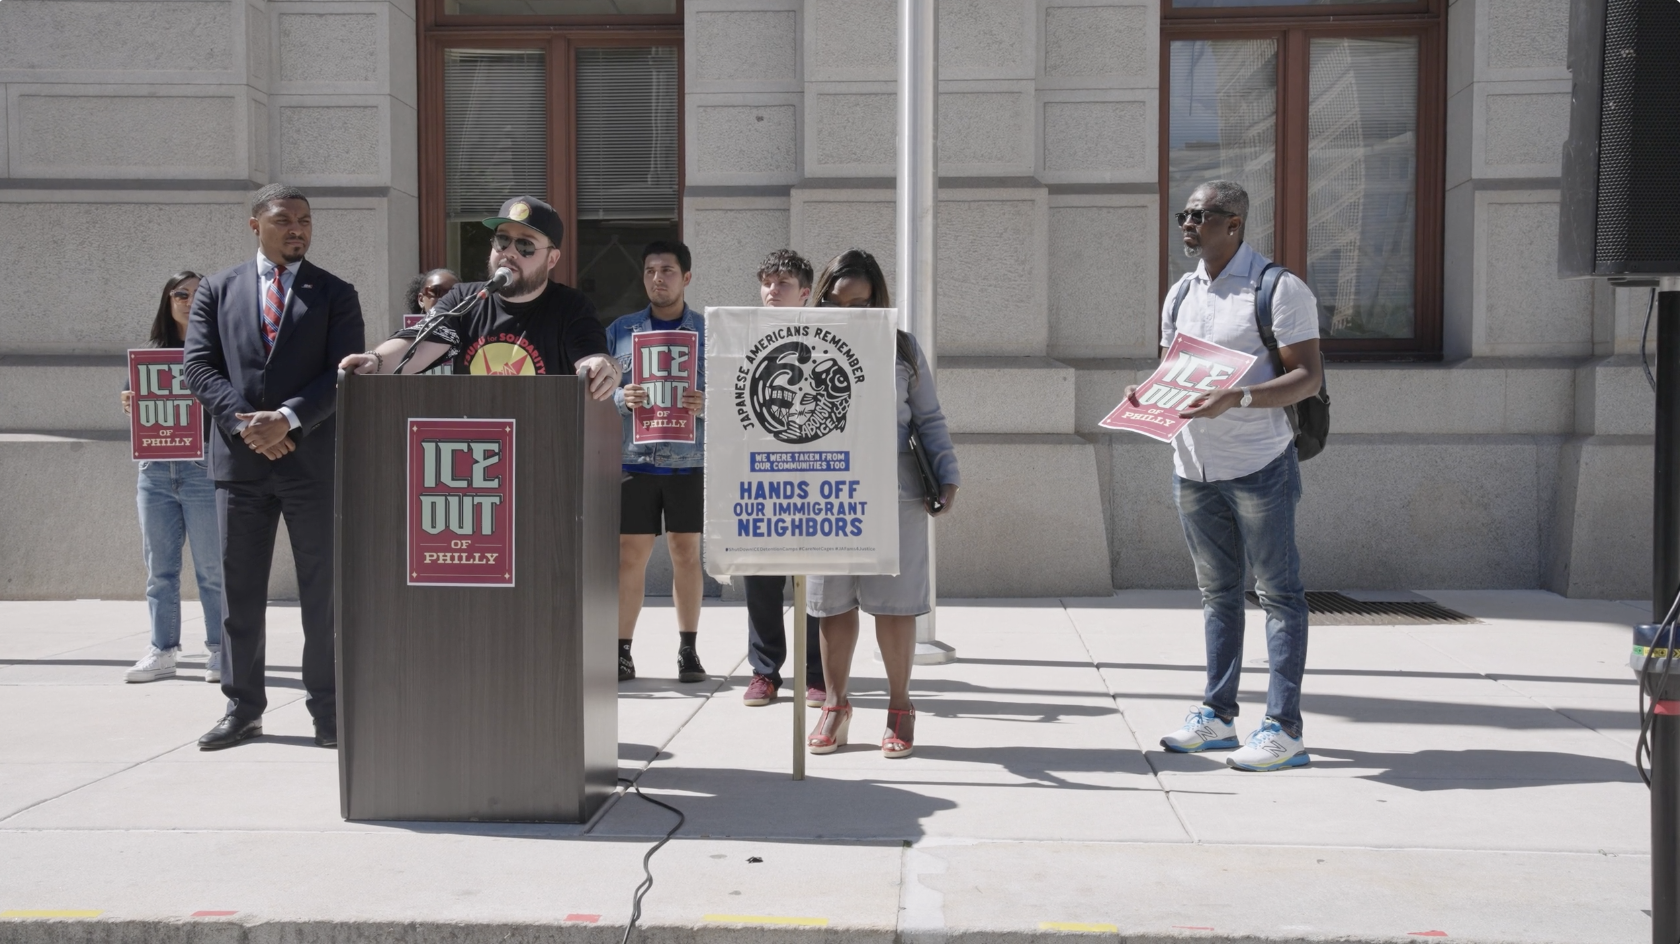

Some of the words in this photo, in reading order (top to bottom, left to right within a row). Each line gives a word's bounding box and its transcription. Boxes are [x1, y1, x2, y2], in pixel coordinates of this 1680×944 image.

[640, 345, 690, 378] ICE
[1162, 351, 1238, 390] ICE
[735, 366, 755, 430] JAPANESE
[745, 326, 809, 364] AMERICANS
[814, 327, 865, 384] REMEMBER
[138, 398, 194, 427] OUT
[801, 395, 832, 438] ABOLISH
[1121, 411, 1176, 427] PHILLY
[642, 419, 687, 429] PHILLY
[816, 413, 838, 437] ICE!
[142, 438, 193, 447] PHILLY
[421, 439, 502, 488] ICE
[754, 462, 771, 470] OUR
[773, 462, 827, 470] COMMUNITIES
[830, 461, 846, 469] TOO
[770, 453, 792, 461] WERE
[794, 453, 820, 461] TAKEN
[740, 480, 810, 500] HANDS
[820, 480, 860, 500] OFF
[419, 493, 503, 535] OUT
[733, 502, 766, 517] OUR
[773, 501, 867, 517] IMMIGRANT
[737, 517, 863, 537] NEIGHBORS
[451, 540, 471, 549] OF
[424, 552, 499, 564] PHILLY
